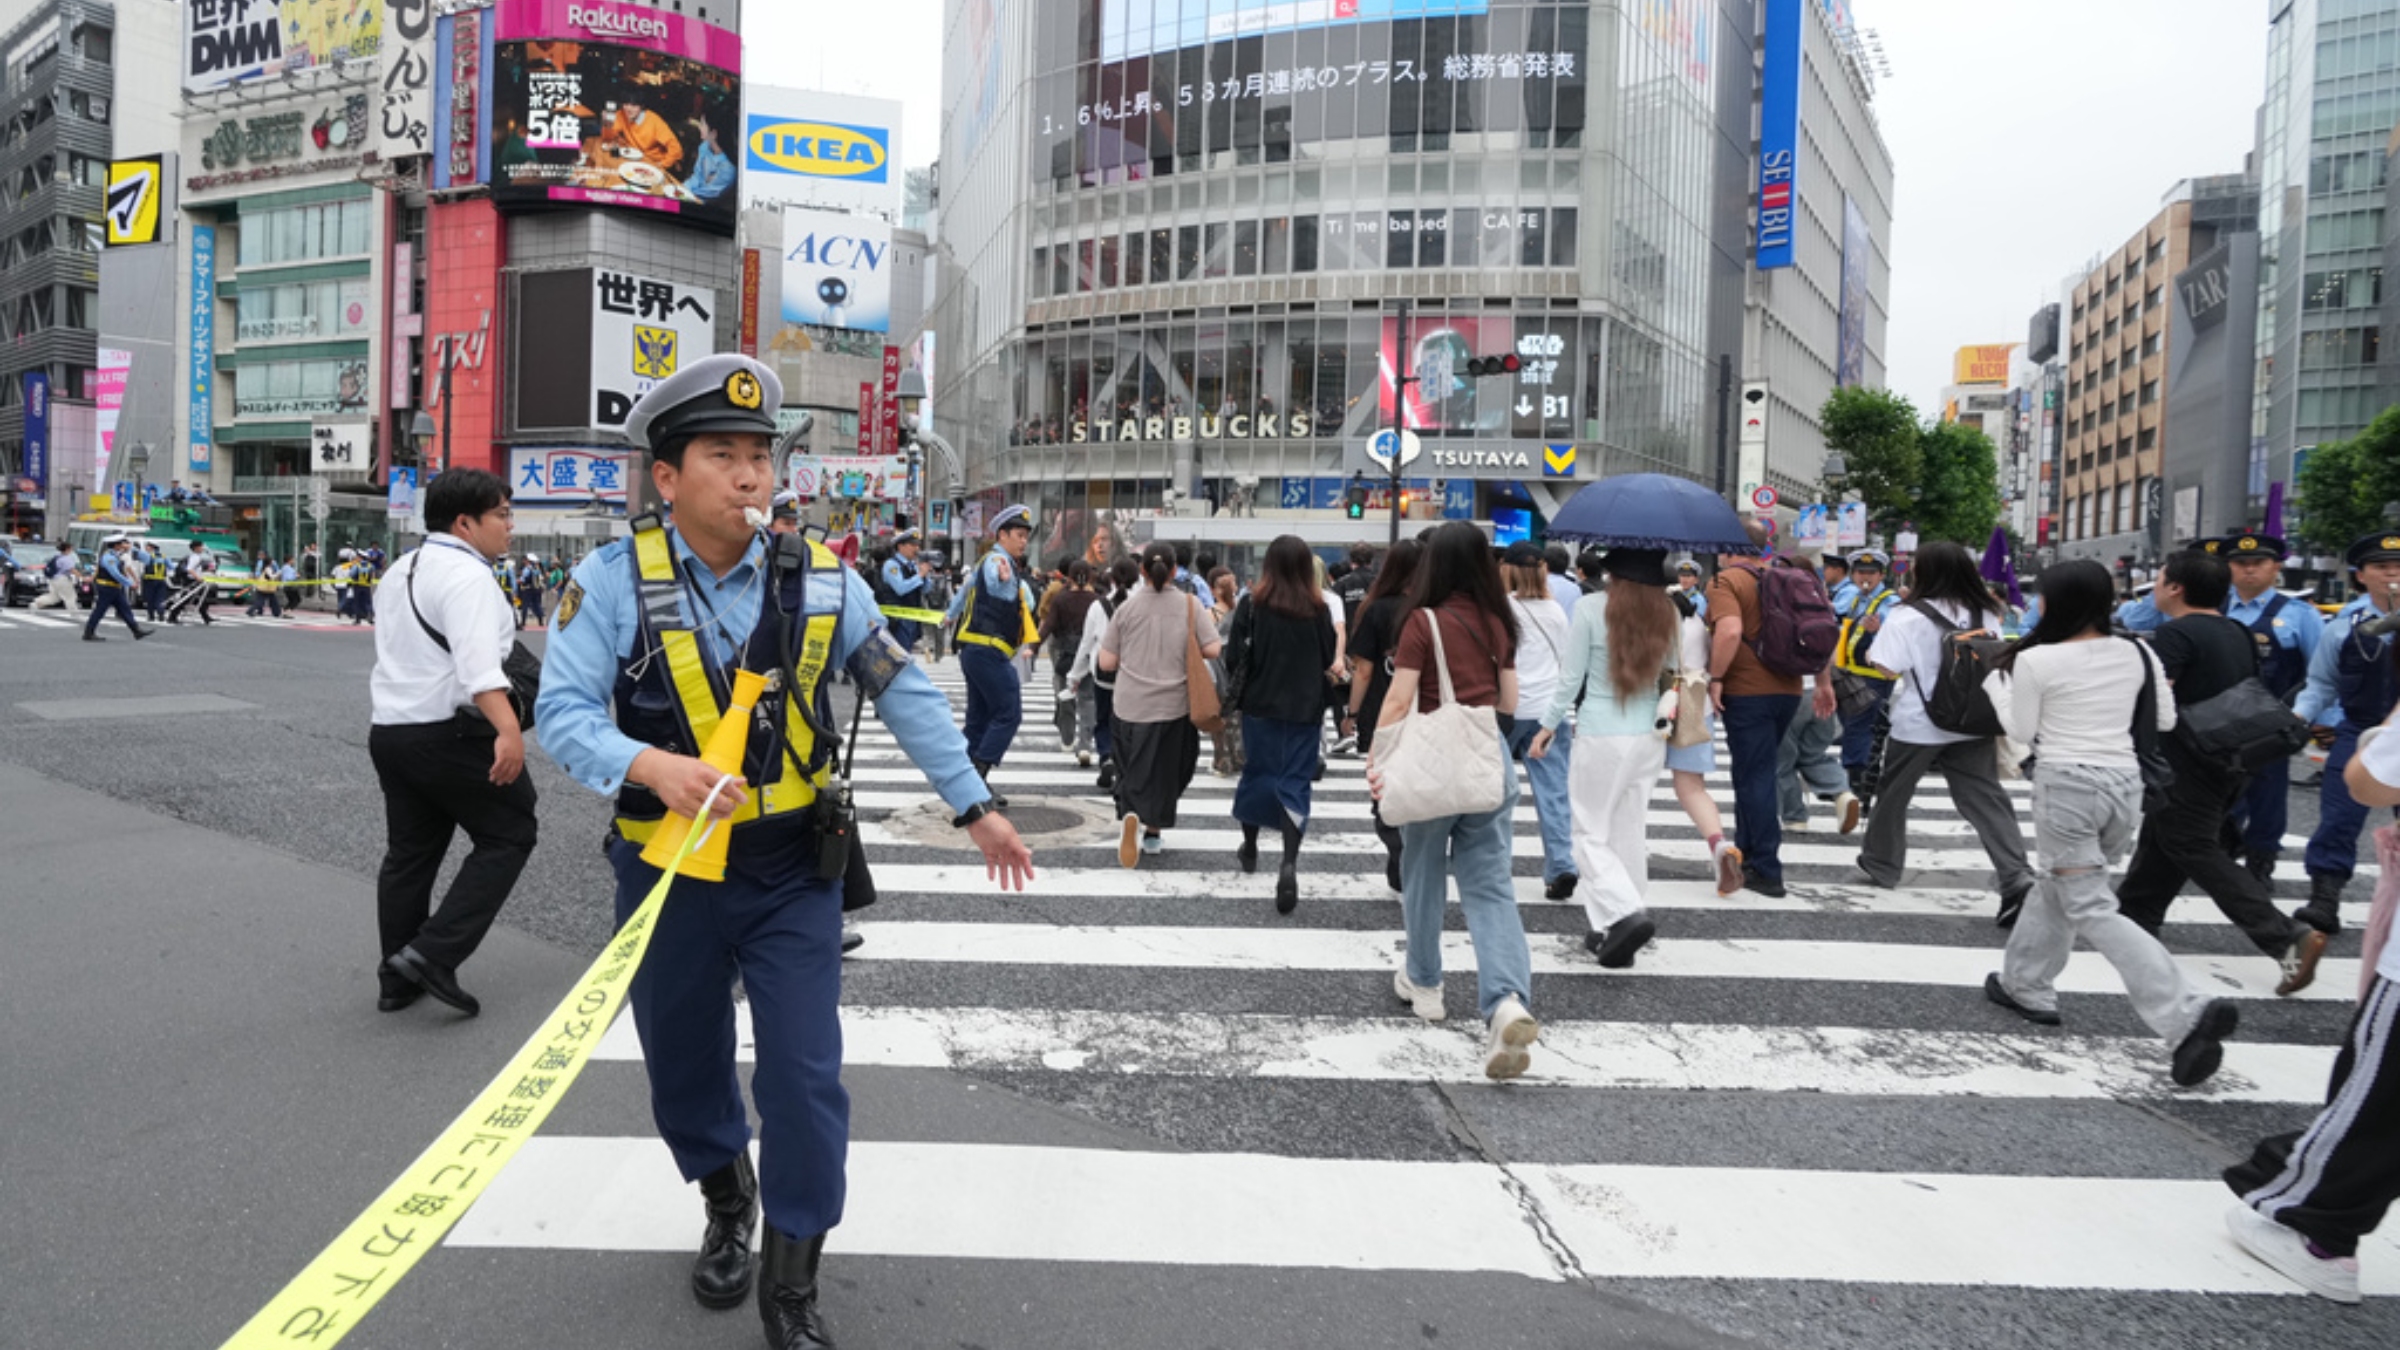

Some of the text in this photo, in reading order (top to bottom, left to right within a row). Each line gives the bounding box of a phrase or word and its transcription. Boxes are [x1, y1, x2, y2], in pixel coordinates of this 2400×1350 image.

[189, 0, 281, 32] 世界
[568, 4, 668, 39] Rakuten
[190, 17, 282, 77] DMM
[528, 109, 580, 144] 5倍
[761, 133, 876, 165] IKEA
[1760, 150, 1791, 248] SEIBU
[1326, 213, 1539, 234] Time based CAFE
[786, 232, 887, 271] ACN
[598, 272, 710, 322] 世界へ
[2183, 265, 2231, 318] ZAR
[428, 309, 491, 406] クスリ
[1543, 395, 1569, 418] B1
[1072, 414, 1310, 442] STARBUCKS
[520, 456, 619, 488] 大盛堂
[1433, 450, 1530, 466] TSUTAYA
